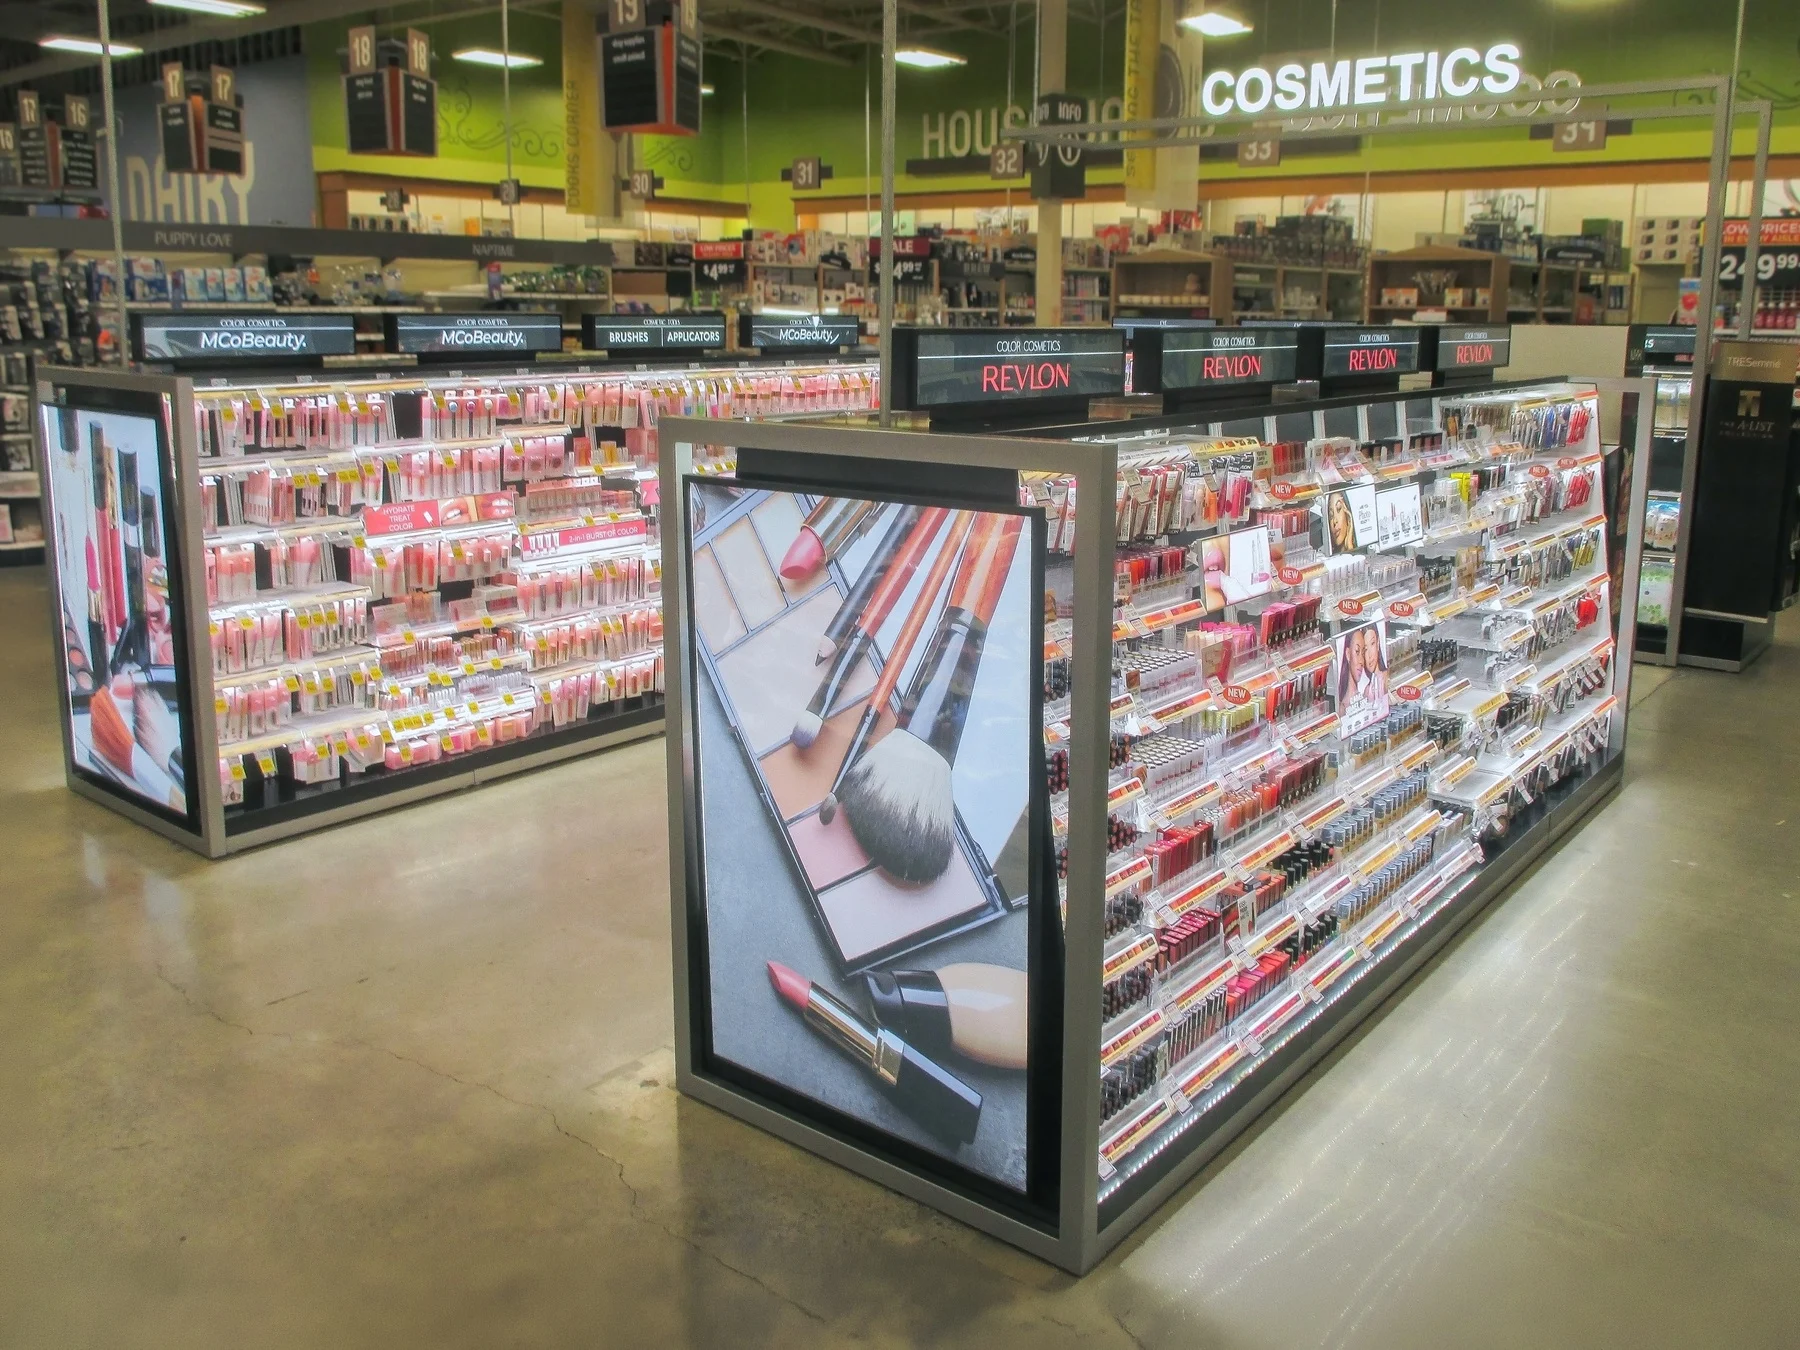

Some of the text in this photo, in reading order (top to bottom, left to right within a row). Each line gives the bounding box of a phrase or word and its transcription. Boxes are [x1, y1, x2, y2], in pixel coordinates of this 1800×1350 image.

[354, 35, 371, 67] 18
[413, 38, 427, 72] 18
[1202, 44, 1520, 116] COSMETICS
[217, 73, 231, 101] 17
[70, 101, 87, 126] 16
[1058, 102, 1082, 121] INFO
[996, 149, 1017, 174] 32
[797, 162, 813, 185] 31
[126, 141, 254, 225] DAIRY
[632, 174, 649, 194] 30
[1723, 222, 1800, 234] OW PRICE
[155, 231, 233, 248] PUPPY LOVE
[472, 244, 515, 257] NAPTIME
[892, 240, 913, 253] ALE
[220, 319, 245, 328] COLOR
[457, 318, 477, 326] COLOR
[201, 332, 307, 350] MCoBeauty.
[442, 329, 524, 346] MCoBeauty.
[609, 330, 720, 343] BRUSHES APPLICATORS
[1213, 337, 1256, 347] COLOR COSMETICS
[996, 340, 1061, 353] COLOR COSMETICS
[1349, 348, 1398, 371] REVLON
[1457, 344, 1493, 364] REVLON
[1203, 355, 1262, 379] REVLON
[1728, 356, 1781, 369] TRESemmé
[982, 362, 1071, 392] REVLON
[1560, 459, 1576, 468] NEW
[1531, 467, 1547, 476] NEW
[1275, 485, 1292, 494] NEW
[383, 505, 416, 516] HYDRATE
[389, 515, 411, 524] TREAT
[389, 523, 414, 532] COLOR
[586, 530, 606, 541] BURST
[617, 526, 639, 537] COLOR
[1282, 569, 1299, 579] NEW
[1342, 601, 1358, 610] NEW
[1394, 603, 1410, 612] NEW
[1227, 687, 1246, 699] NEW
[1400, 687, 1417, 696] NEW
